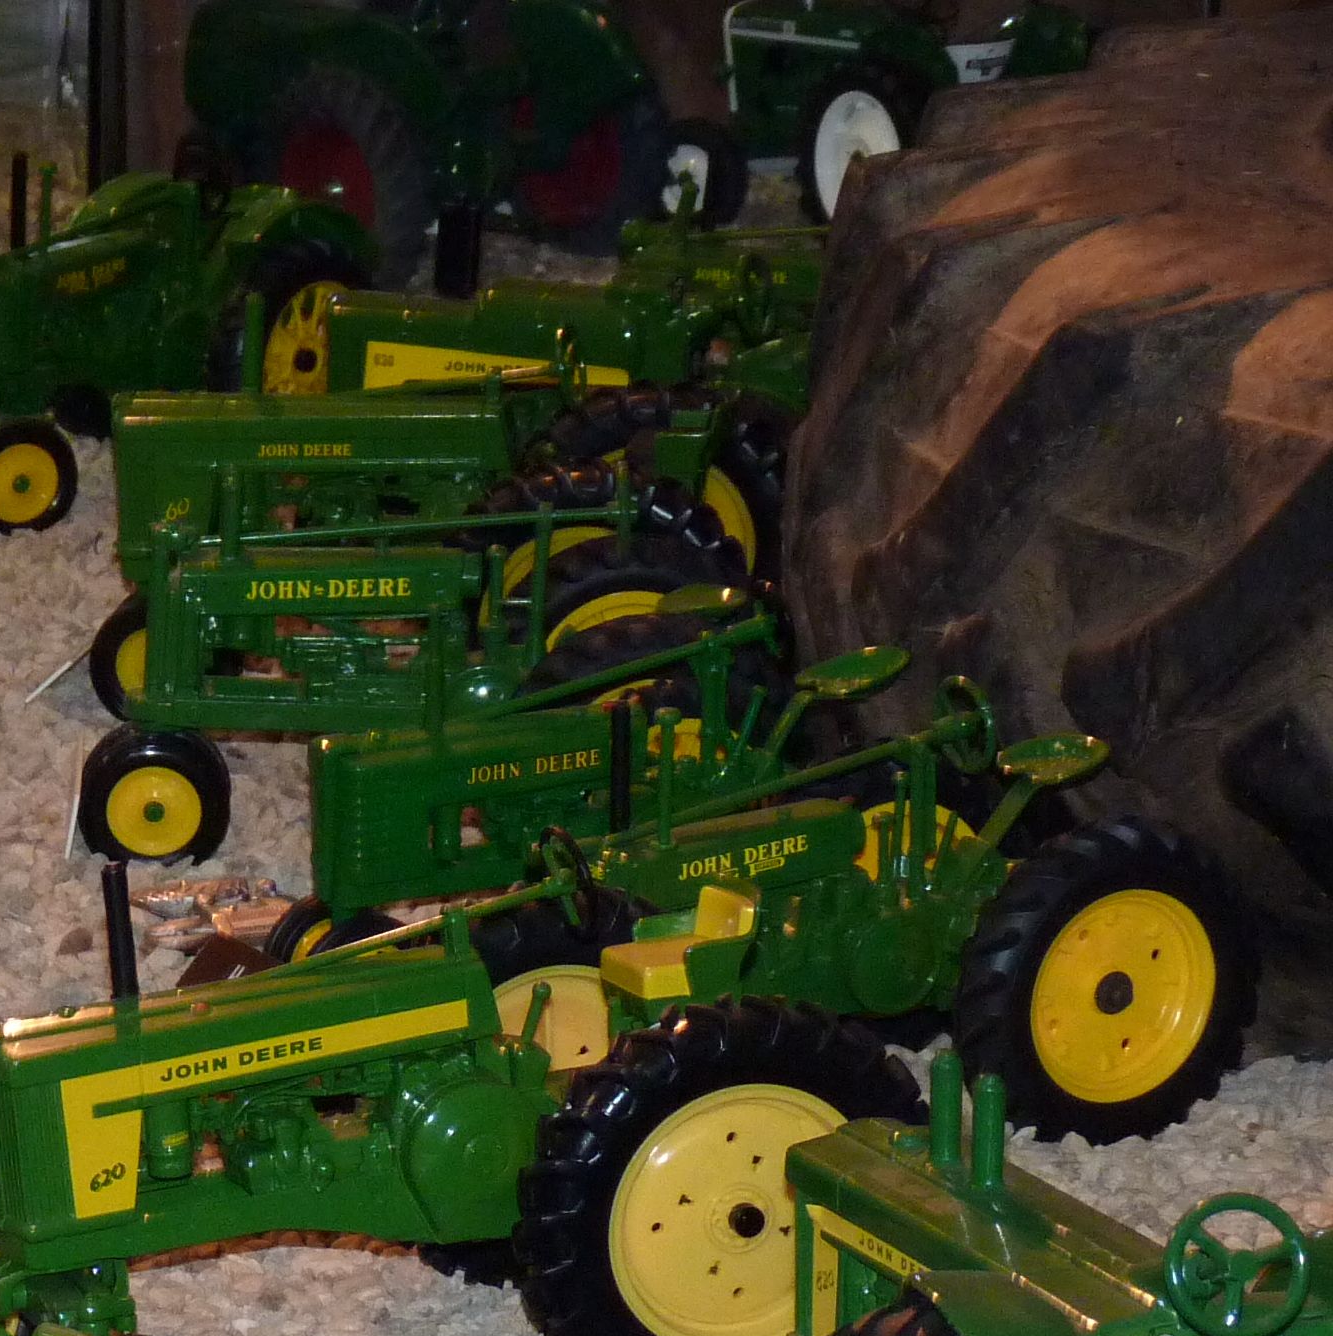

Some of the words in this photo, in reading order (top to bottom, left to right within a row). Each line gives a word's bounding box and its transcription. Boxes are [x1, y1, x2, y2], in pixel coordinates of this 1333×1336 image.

[443, 360, 486, 373] JOHN
[257, 443, 299, 458] JOHN
[303, 443, 353, 457] DEERE
[165, 496, 190, 523] 60
[246, 579, 311, 601] JOHN
[327, 577, 412, 599] DEERE
[467, 762, 523, 786] JOHN
[535, 748, 602, 775] DEERE
[678, 851, 733, 882] JOHN
[743, 833, 809, 866] DEERE
[159, 1055, 228, 1083] JOHN
[238, 1036, 324, 1067] DEERE
[88, 1161, 127, 1193] 620
[859, 1232, 893, 1262] JOHN
